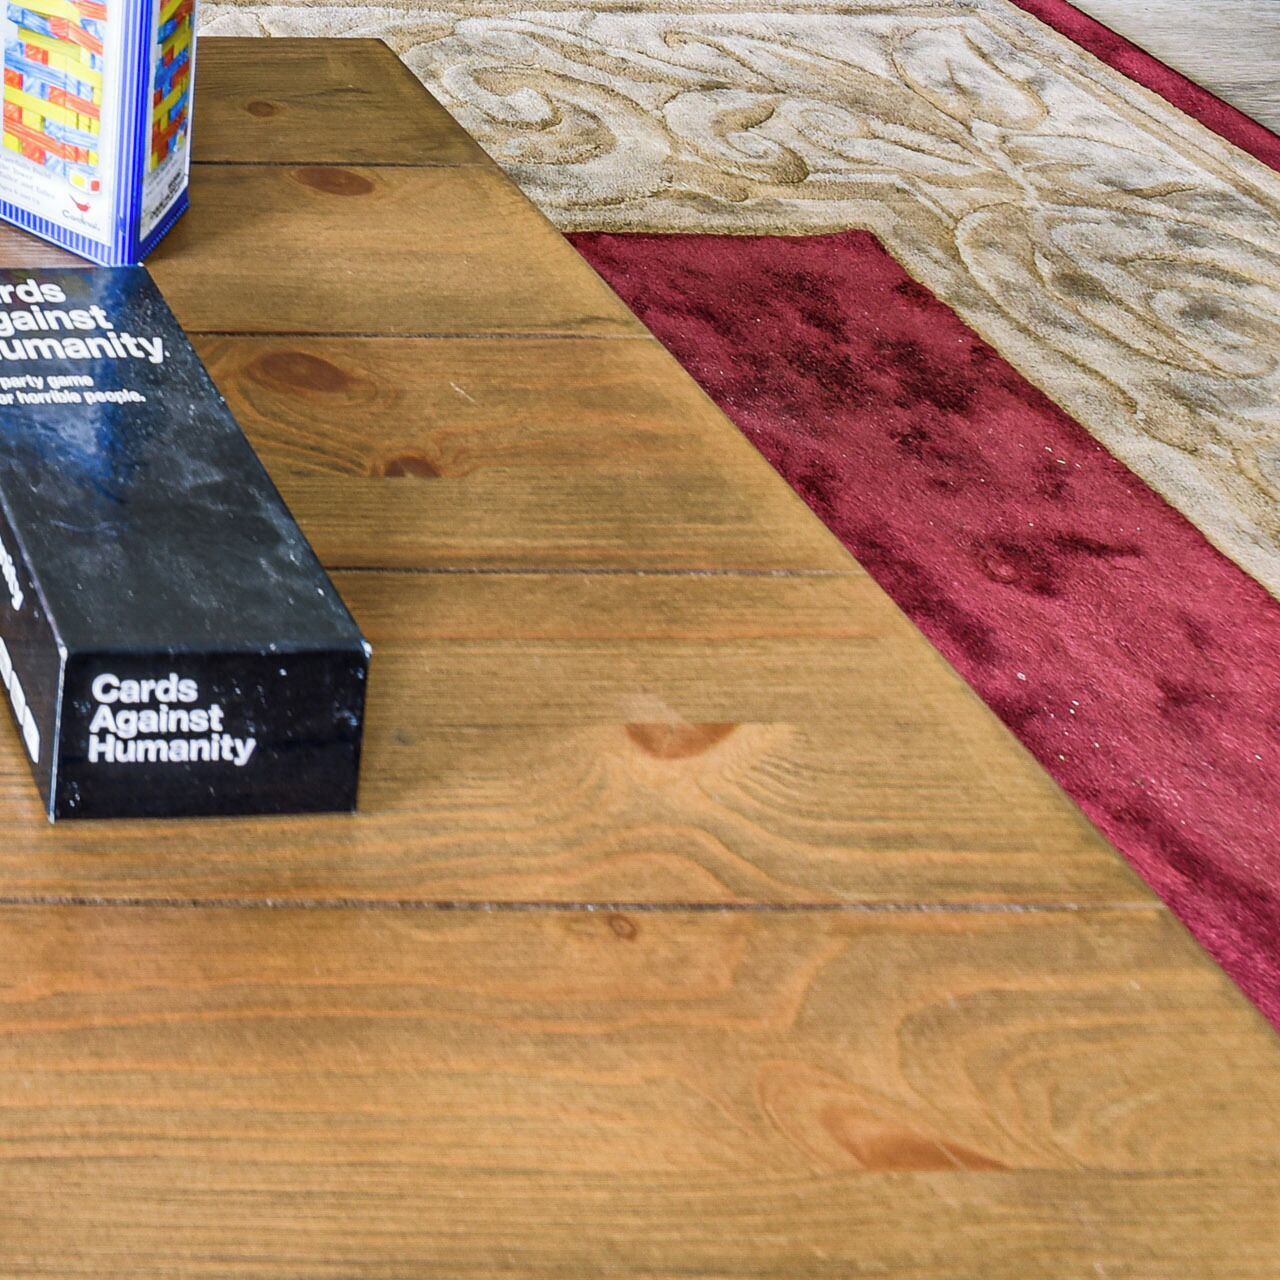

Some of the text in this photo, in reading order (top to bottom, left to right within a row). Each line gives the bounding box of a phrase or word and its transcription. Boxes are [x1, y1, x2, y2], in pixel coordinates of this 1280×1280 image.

[0, 373, 44, 391] party
[46, 374, 93, 389] game
[17, 390, 80, 405] horrible
[84, 391, 146, 407] people.
[91, 673, 198, 703] Cards
[89, 704, 224, 736] Against
[88, 735, 256, 766] Humanity
